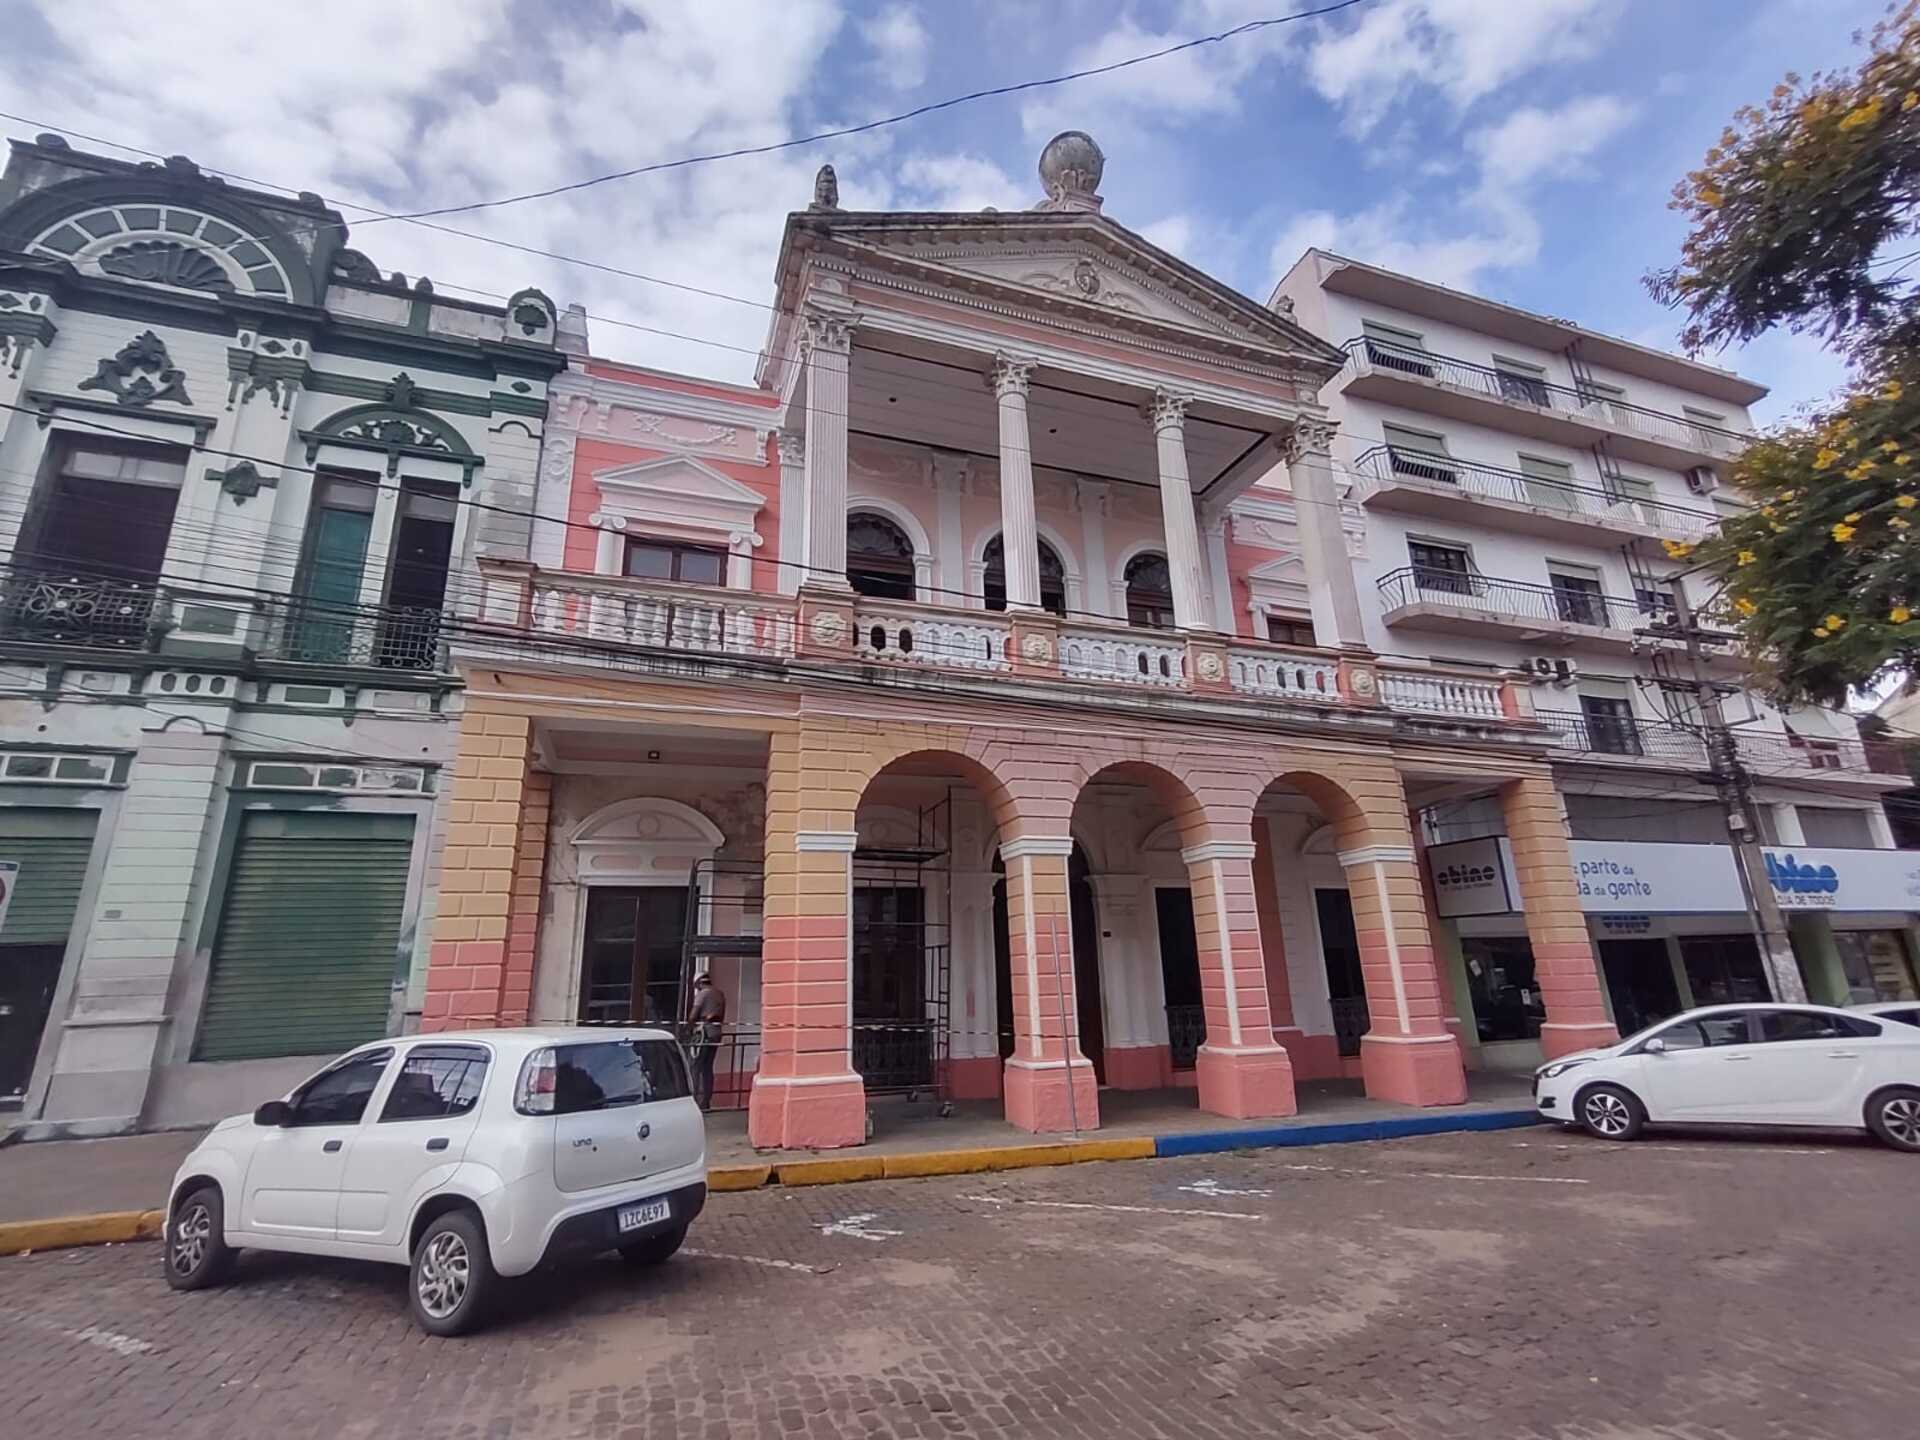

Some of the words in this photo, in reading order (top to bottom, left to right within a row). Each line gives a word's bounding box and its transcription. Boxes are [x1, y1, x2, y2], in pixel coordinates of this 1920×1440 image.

[1580, 858, 1620, 878] parte
[1623, 865, 1634, 875] da
[1764, 852, 1839, 893] bino
[1594, 885, 1606, 896] da
[1607, 878, 1652, 901] gente
[1776, 895, 1793, 905] OJA
[1795, 895, 1807, 905] DE
[1808, 895, 1836, 905] TODOS
